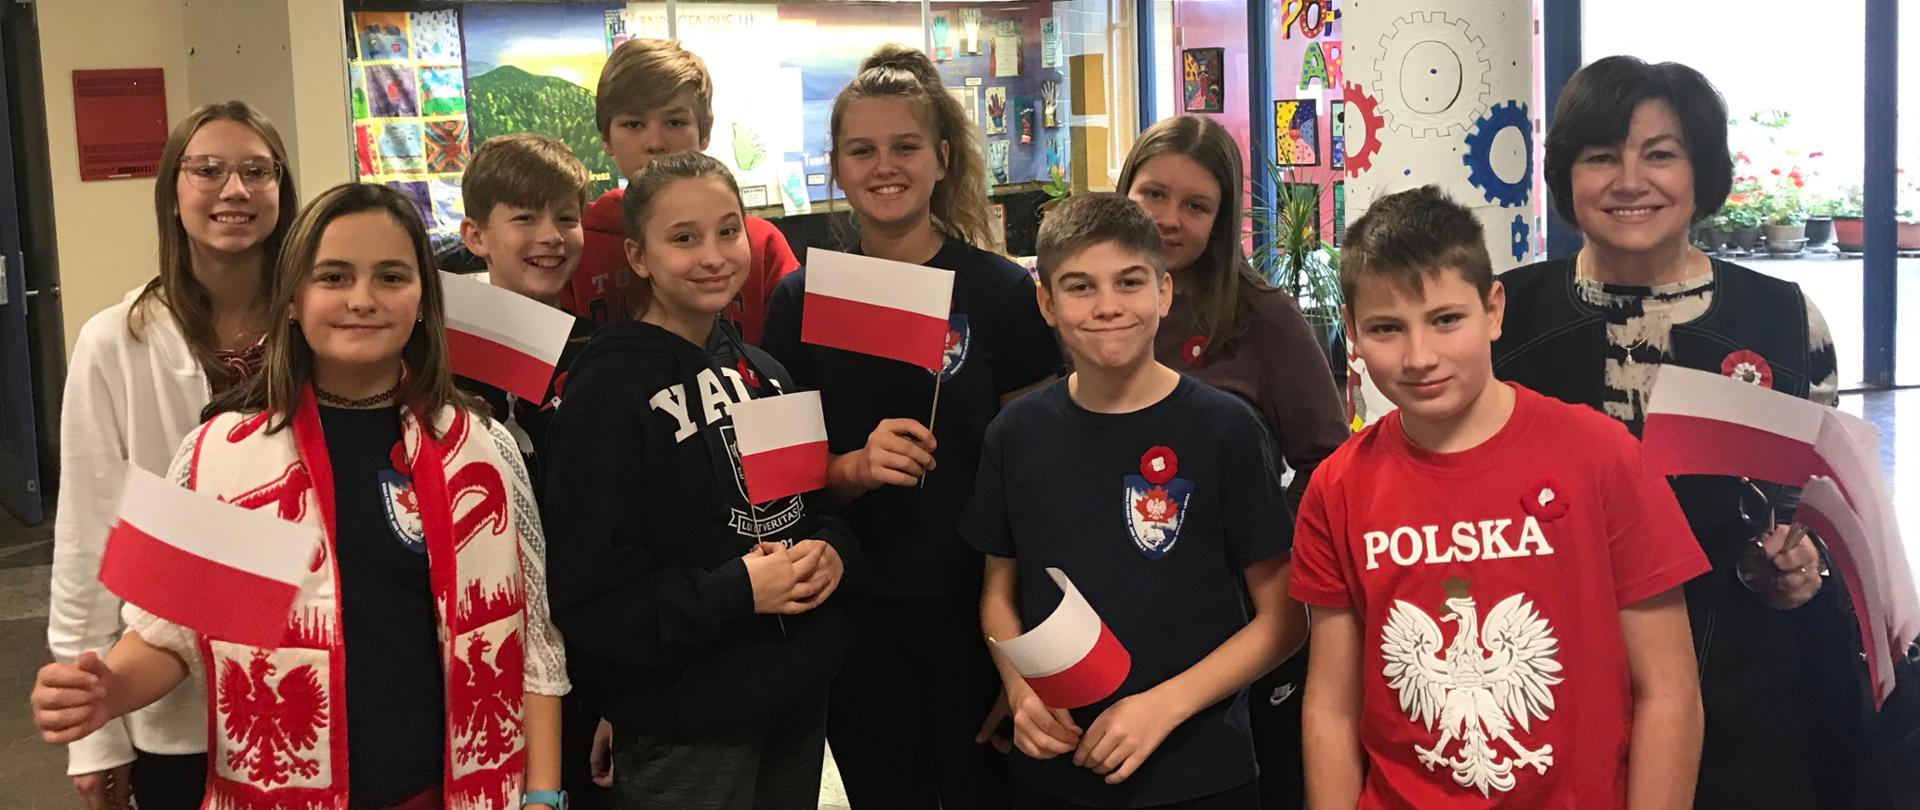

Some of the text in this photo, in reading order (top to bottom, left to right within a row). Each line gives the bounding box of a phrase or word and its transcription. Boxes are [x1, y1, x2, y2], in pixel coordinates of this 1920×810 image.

[639, 14, 734, 34] INDGENOUS
[649, 366, 783, 444] YAL
[763, 507, 798, 531] VERITAS
[1363, 515, 1555, 571] POLSKA
